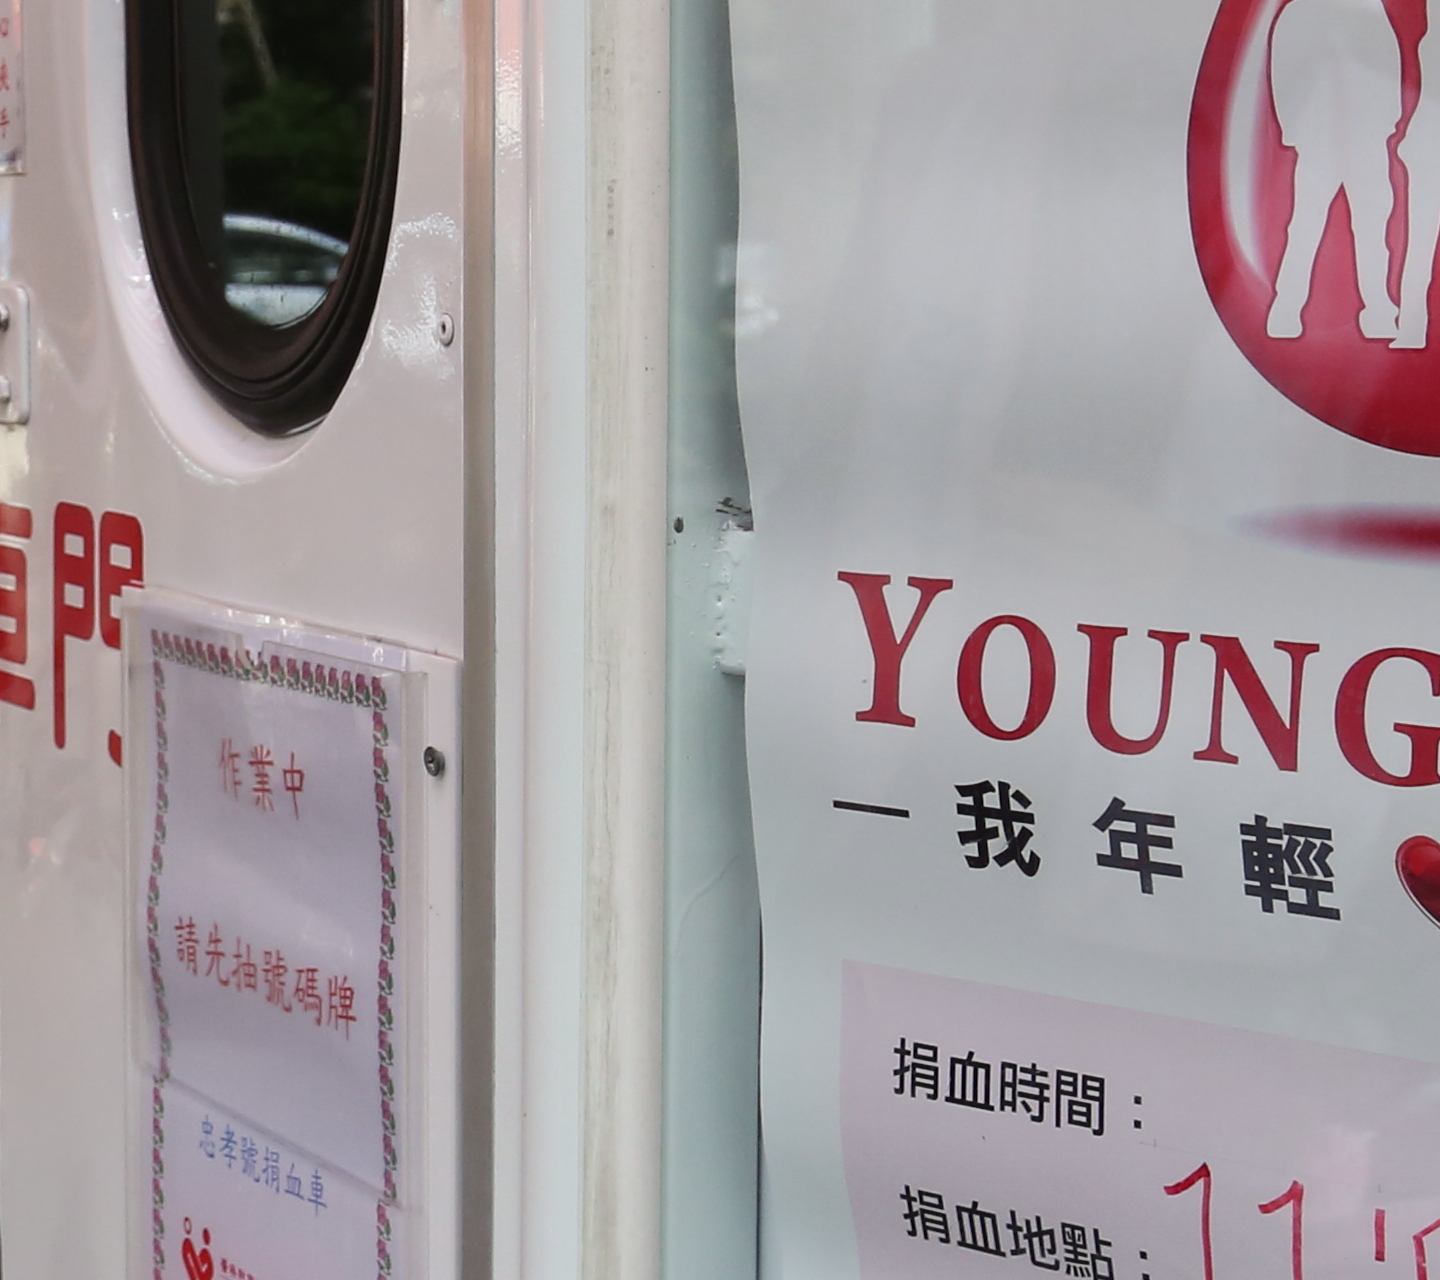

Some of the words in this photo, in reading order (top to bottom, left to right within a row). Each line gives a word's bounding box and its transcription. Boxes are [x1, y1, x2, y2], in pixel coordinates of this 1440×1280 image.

[217, 736, 306, 821] 作業中
[173, 915, 359, 1042] 請先抽號碼牌
[892, 1037, 1145, 1138] 捐血時間：
[198, 1113, 328, 1217] 忠孝號捐血車
